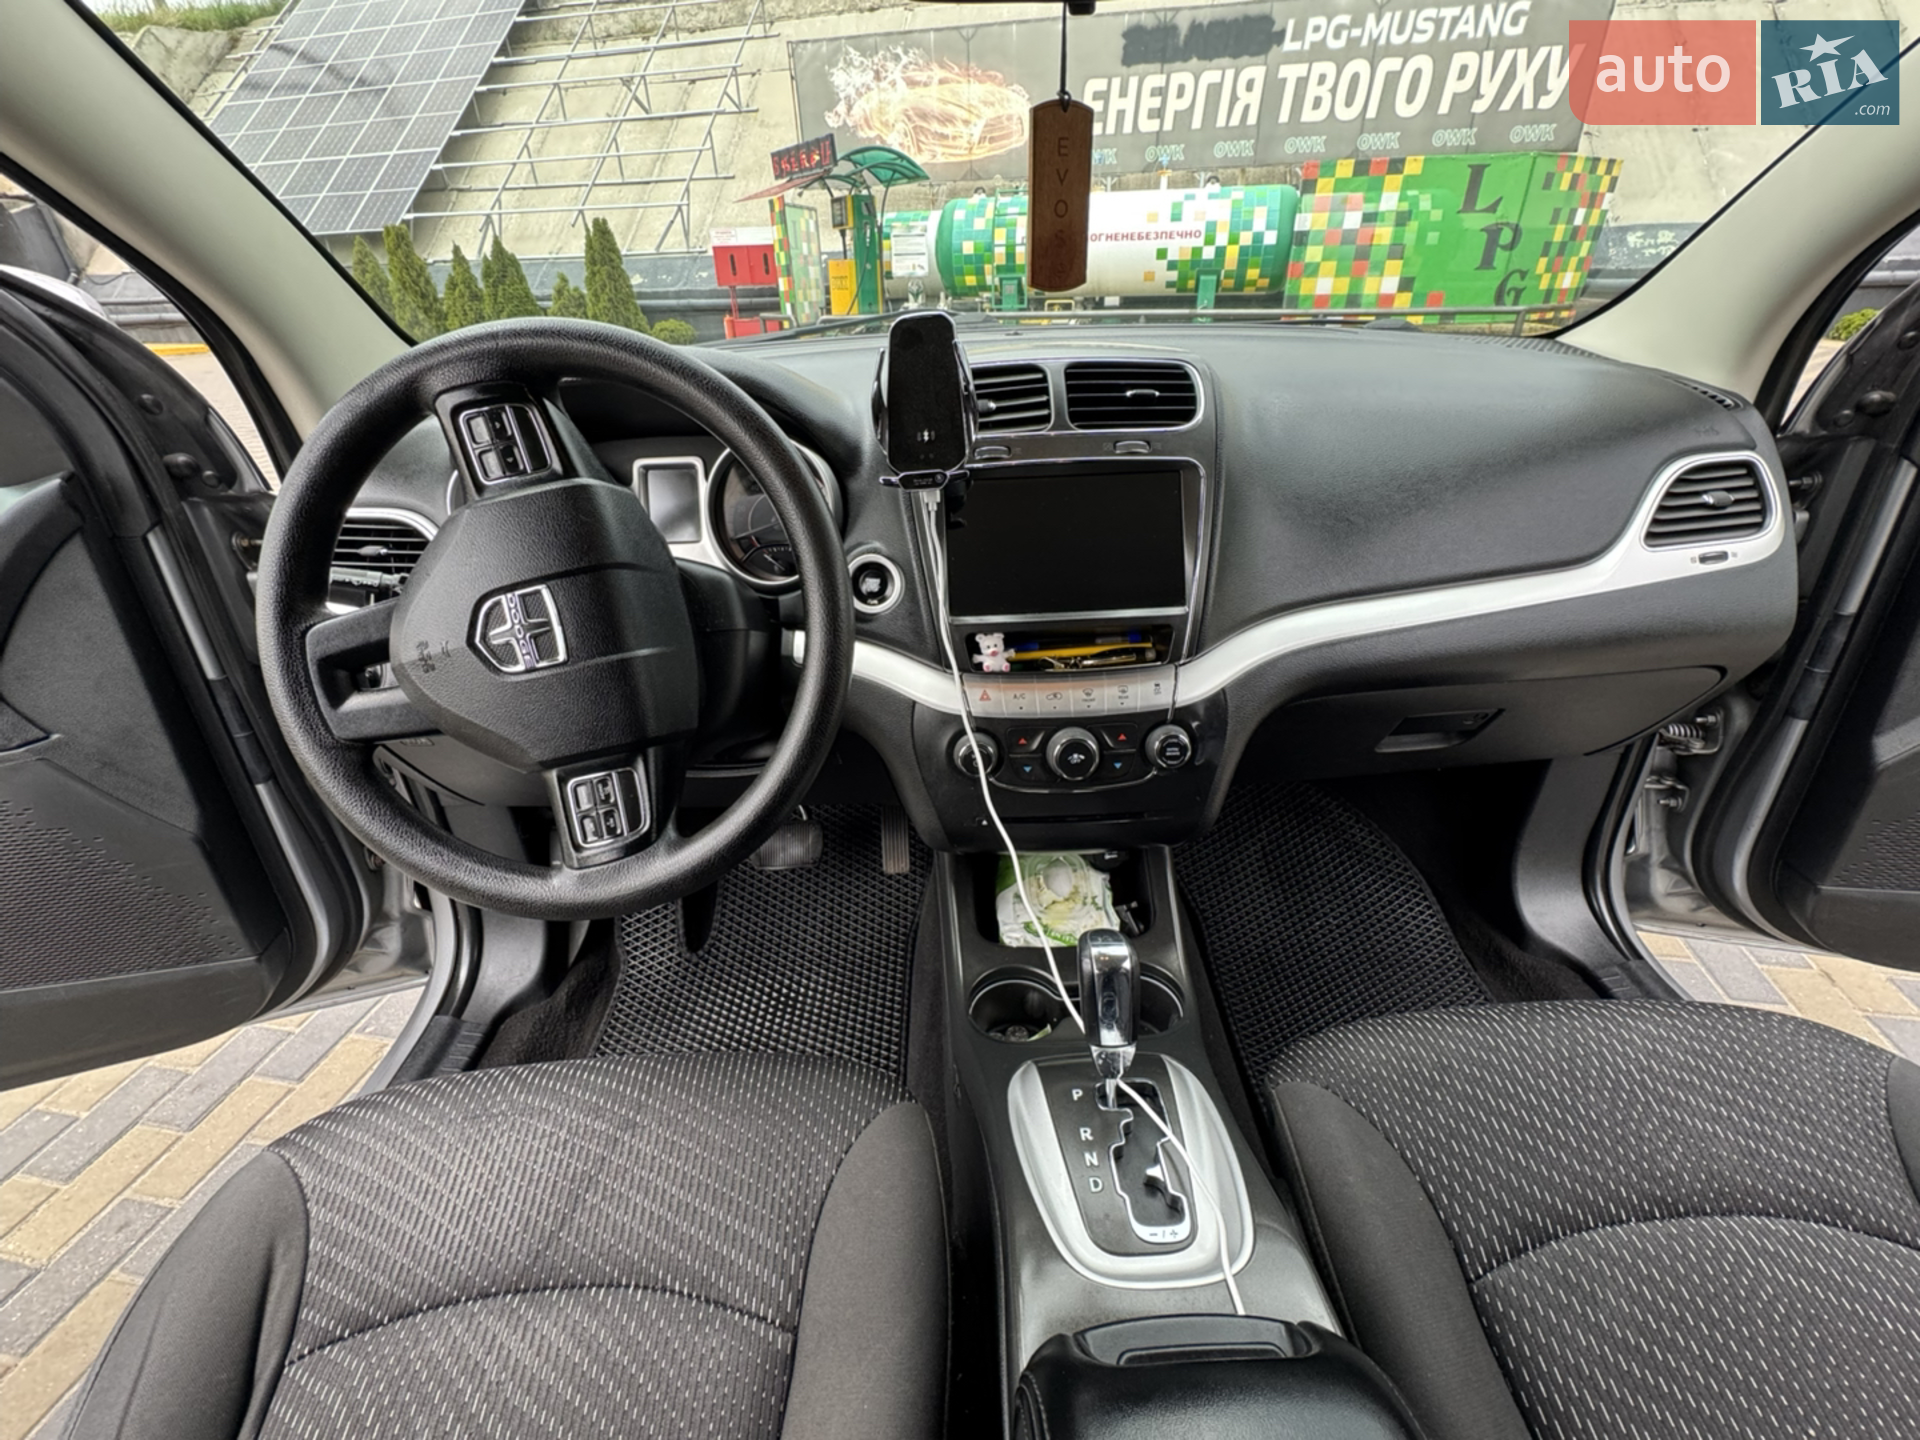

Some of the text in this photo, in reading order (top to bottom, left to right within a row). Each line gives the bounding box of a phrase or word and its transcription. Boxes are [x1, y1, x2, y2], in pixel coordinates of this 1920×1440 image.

[1282, 0, 1532, 51] LPG-MUSTANG
[1083, 43, 1587, 136] ЕНЕРГІЯ ТВОГО РУХУ
[1092, 148, 1118, 164] WK
[1090, 229, 1203, 242] ОГНЕНЕБЕЗПЕЧНО
[1456, 163, 1531, 307] LPG
[1072, 1088, 1083, 1101] P
[1080, 1127, 1094, 1141] R
[1084, 1151, 1099, 1167] N
[1089, 1177, 1104, 1193] D
